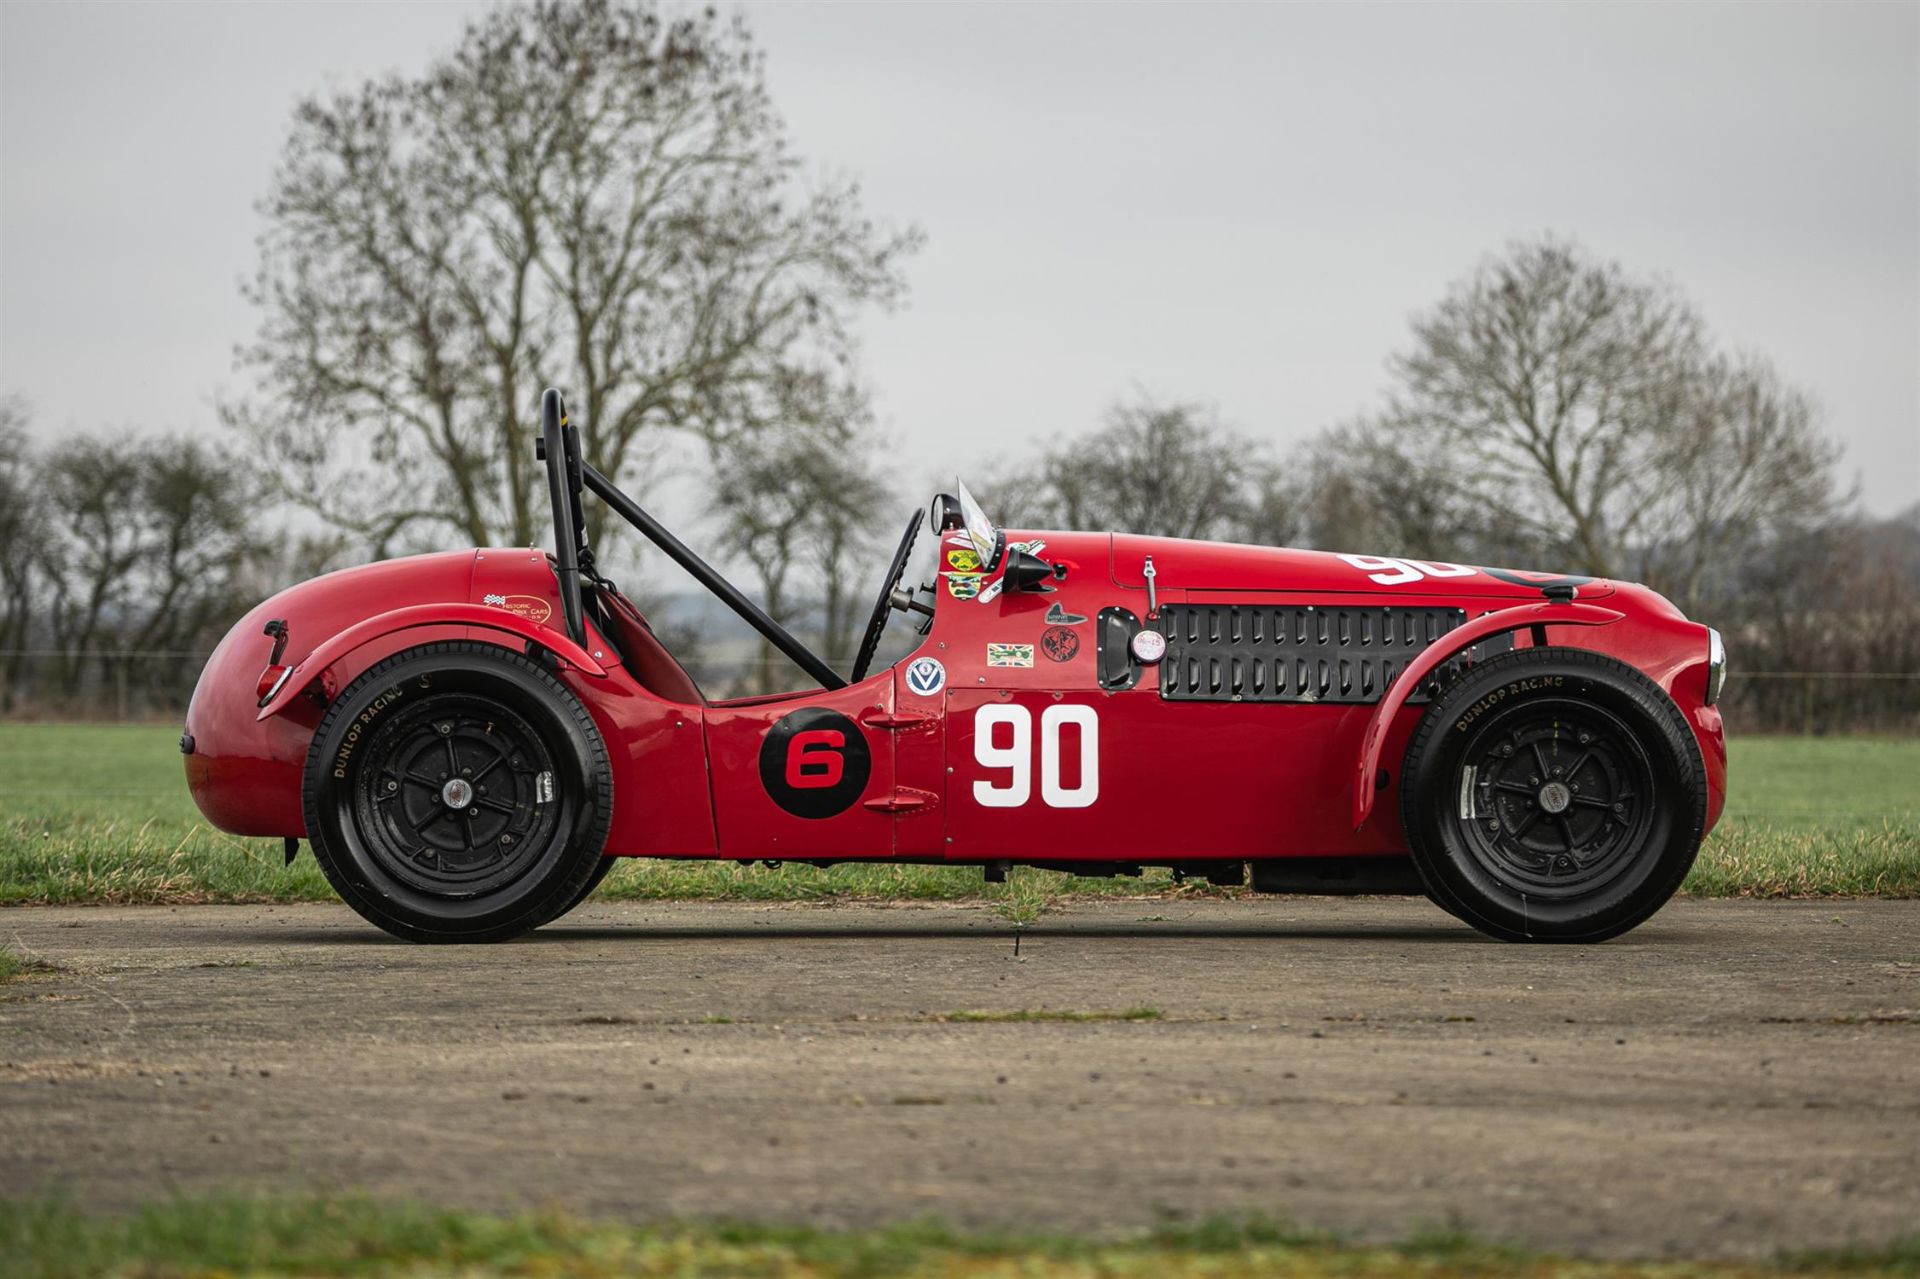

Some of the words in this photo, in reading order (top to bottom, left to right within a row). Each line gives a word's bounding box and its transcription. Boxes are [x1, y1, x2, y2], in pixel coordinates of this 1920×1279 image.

[1337, 554, 1477, 586] 90
[334, 723, 362, 778] DUNLOP
[361, 687, 403, 724] RACING
[1456, 689, 1506, 732] DUNLOP
[1509, 676, 1564, 695] RACING
[785, 729, 846, 789] 6
[973, 704, 1099, 808] 90
